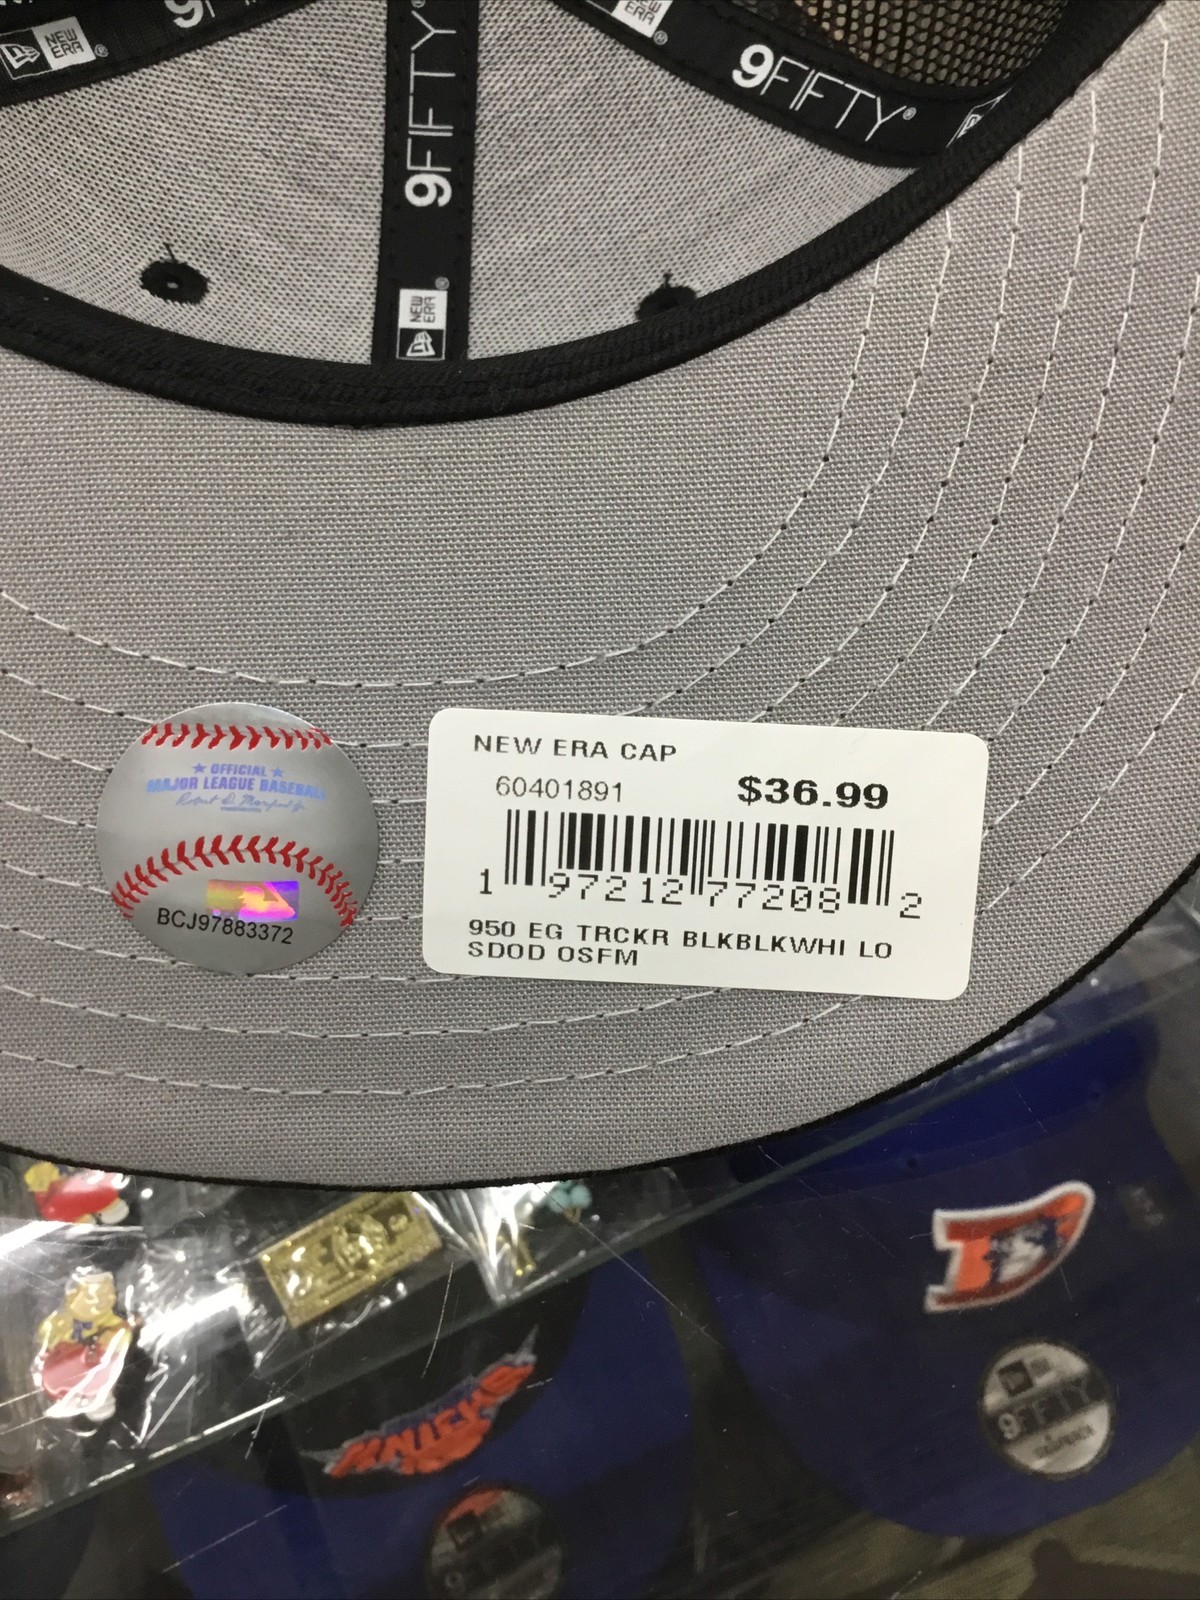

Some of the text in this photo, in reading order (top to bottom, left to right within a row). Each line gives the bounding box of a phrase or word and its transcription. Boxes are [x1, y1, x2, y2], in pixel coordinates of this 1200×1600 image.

[624, 1, 656, 25] ERA
[44, 27, 78, 46] NEW
[51, 41, 84, 59] ERA
[732, 44, 908, 142] 9FIFTY
[404, 10, 457, 207] 9FIFTY
[410, 295, 423, 323] NEW
[423, 296, 437, 323] ERA
[474, 734, 677, 762] NEW ERA CAP
[210, 763, 267, 777] OFFICIAL
[147, 776, 327, 800] MAJOR LEAGUE BASEBALL
[496, 775, 888, 809] 60401891 $36.99
[480, 868, 922, 919] 1 97212 77208 2
[156, 907, 294, 945] BCJ97883372
[469, 919, 893, 959] 950 EG TRCKR BLKBLKWHI LO
[468, 941, 638, 966] SDOD OSFM
